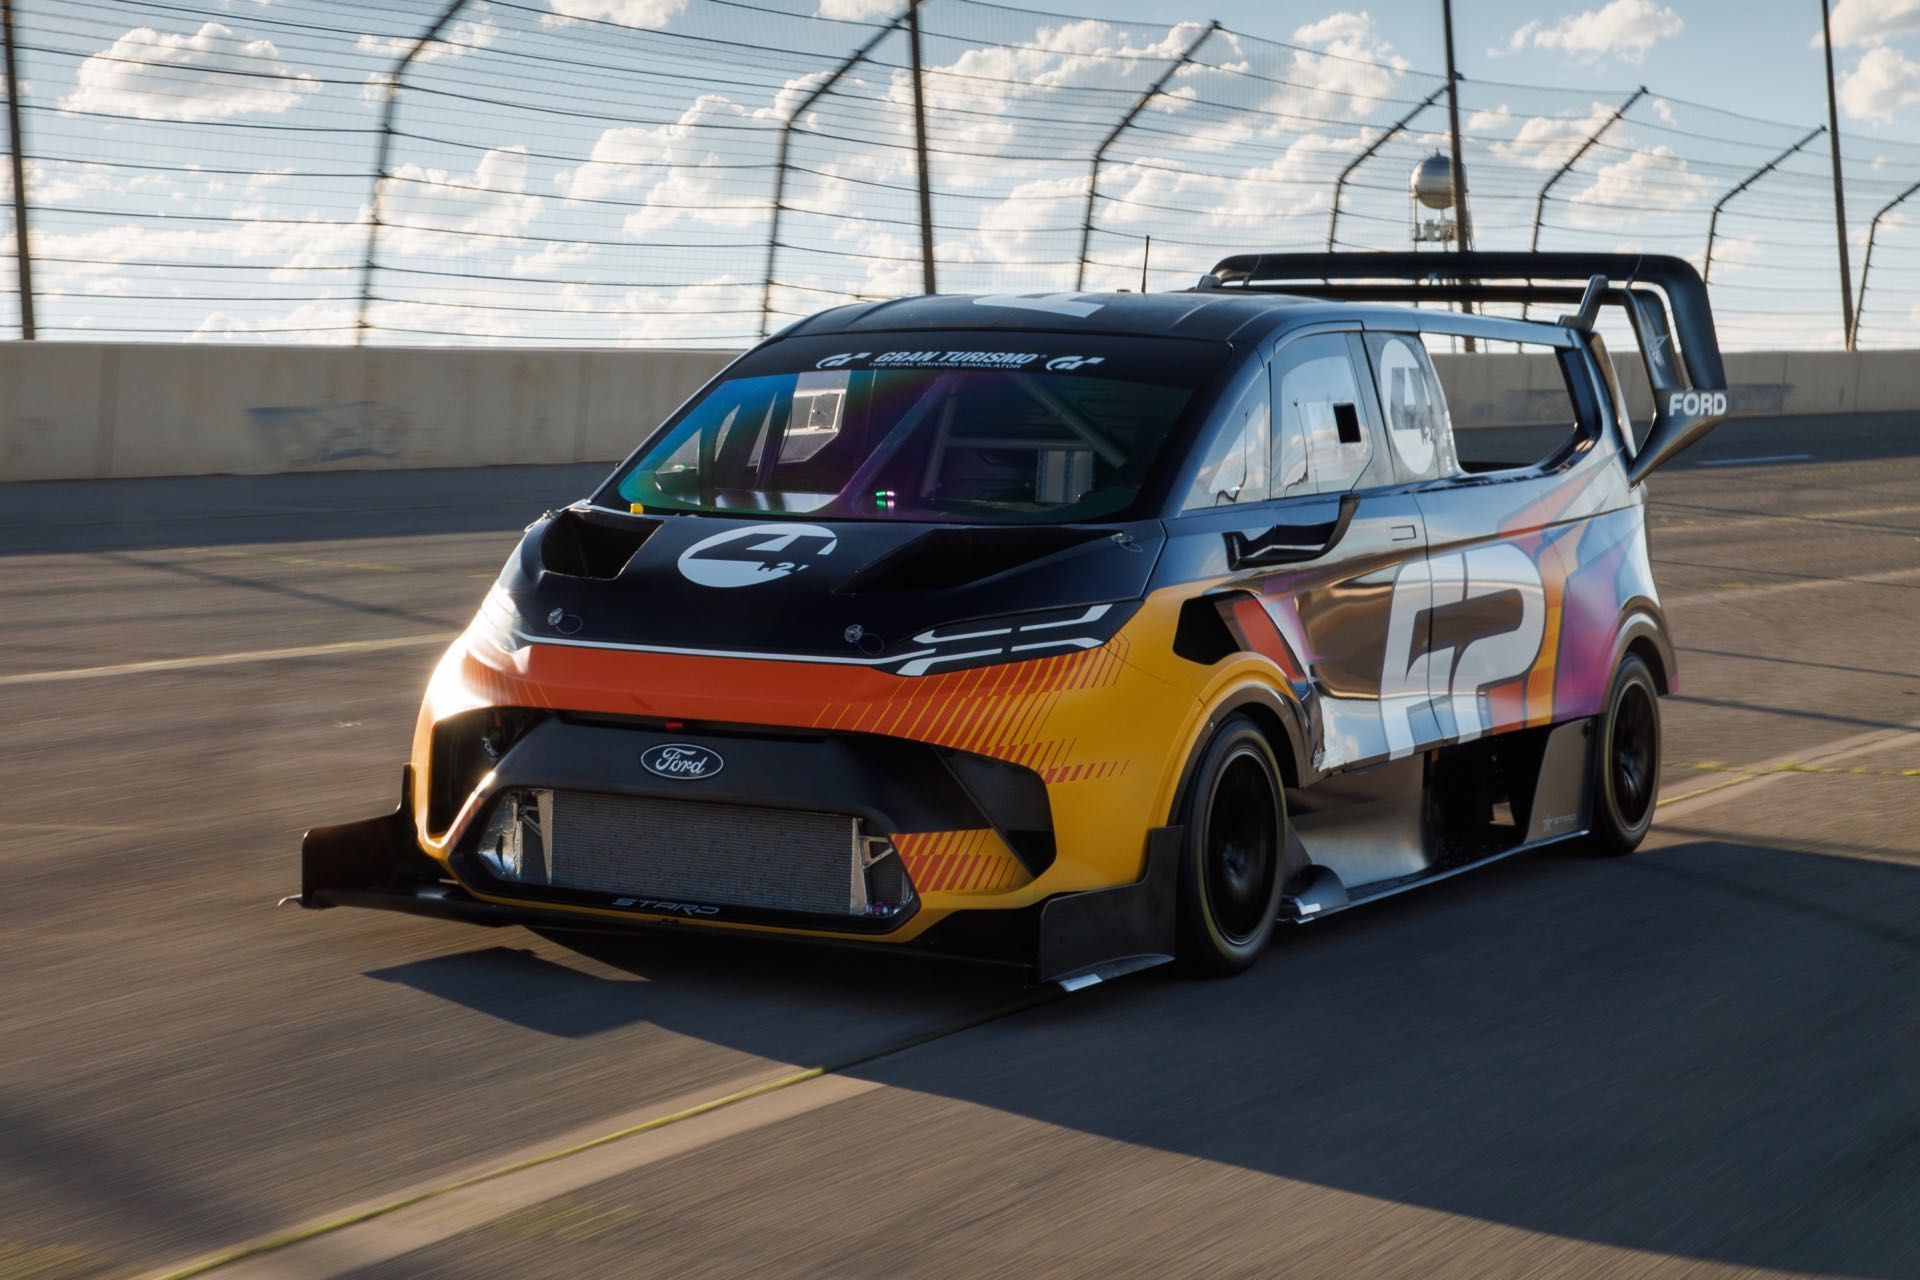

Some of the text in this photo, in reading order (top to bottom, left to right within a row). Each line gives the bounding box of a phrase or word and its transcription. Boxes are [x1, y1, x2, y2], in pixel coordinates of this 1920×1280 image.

[874, 351, 1039, 364] GRAN TURISMO
[1668, 392, 1727, 417] FORD
[655, 747, 708, 774] Ford
[611, 898, 720, 916] STARD
